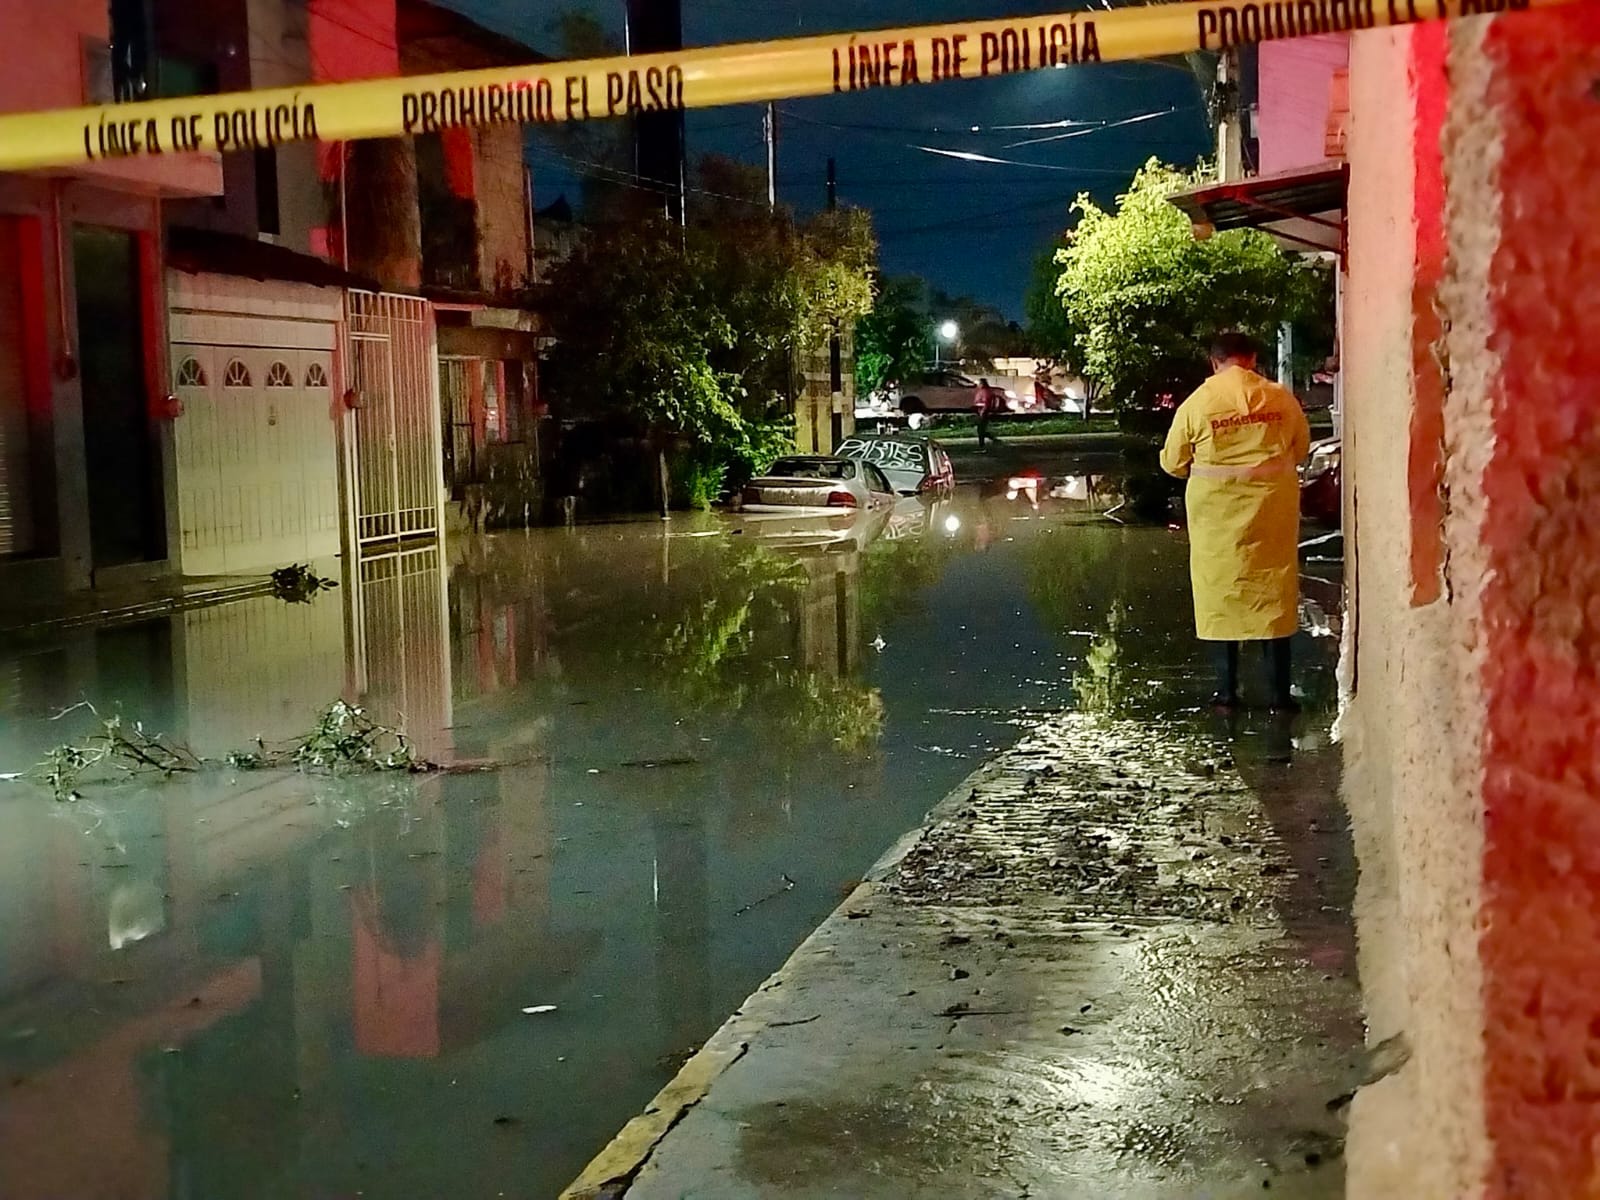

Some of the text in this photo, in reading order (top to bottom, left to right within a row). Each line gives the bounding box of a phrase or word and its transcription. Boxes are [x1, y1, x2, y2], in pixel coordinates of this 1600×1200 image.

[832, 12, 1101, 92] LÍNEA DE POLICÍA
[84, 91, 319, 159] LÍNEA DE POLICÍA
[402, 64, 686, 133] PROHIBIDO EL PASO
[834, 439, 924, 462] PARTES
[1211, 411, 1283, 430] BOMBEROS
